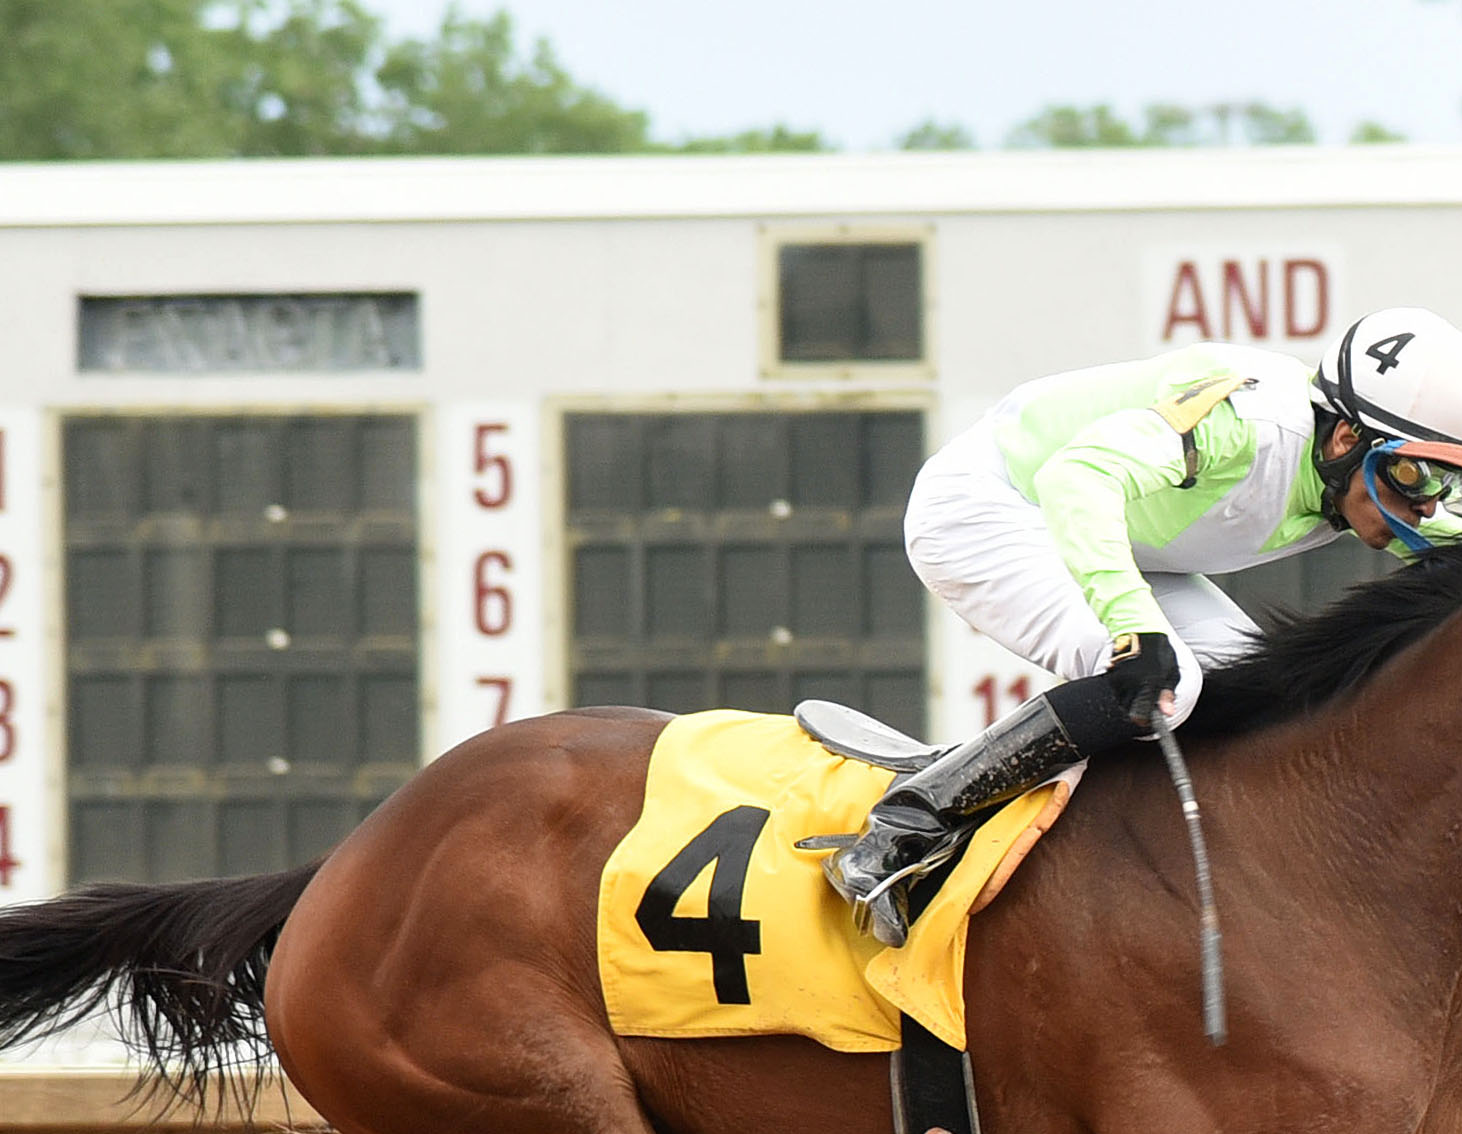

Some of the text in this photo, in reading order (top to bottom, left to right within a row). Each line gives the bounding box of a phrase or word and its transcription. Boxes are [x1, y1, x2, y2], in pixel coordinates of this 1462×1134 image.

[1161, 258, 1331, 341] AND
[1365, 332, 1415, 375] 4
[474, 423, 514, 509] 5
[474, 551, 514, 636] 6
[475, 676, 513, 728] 7
[635, 805, 770, 1004] 4
